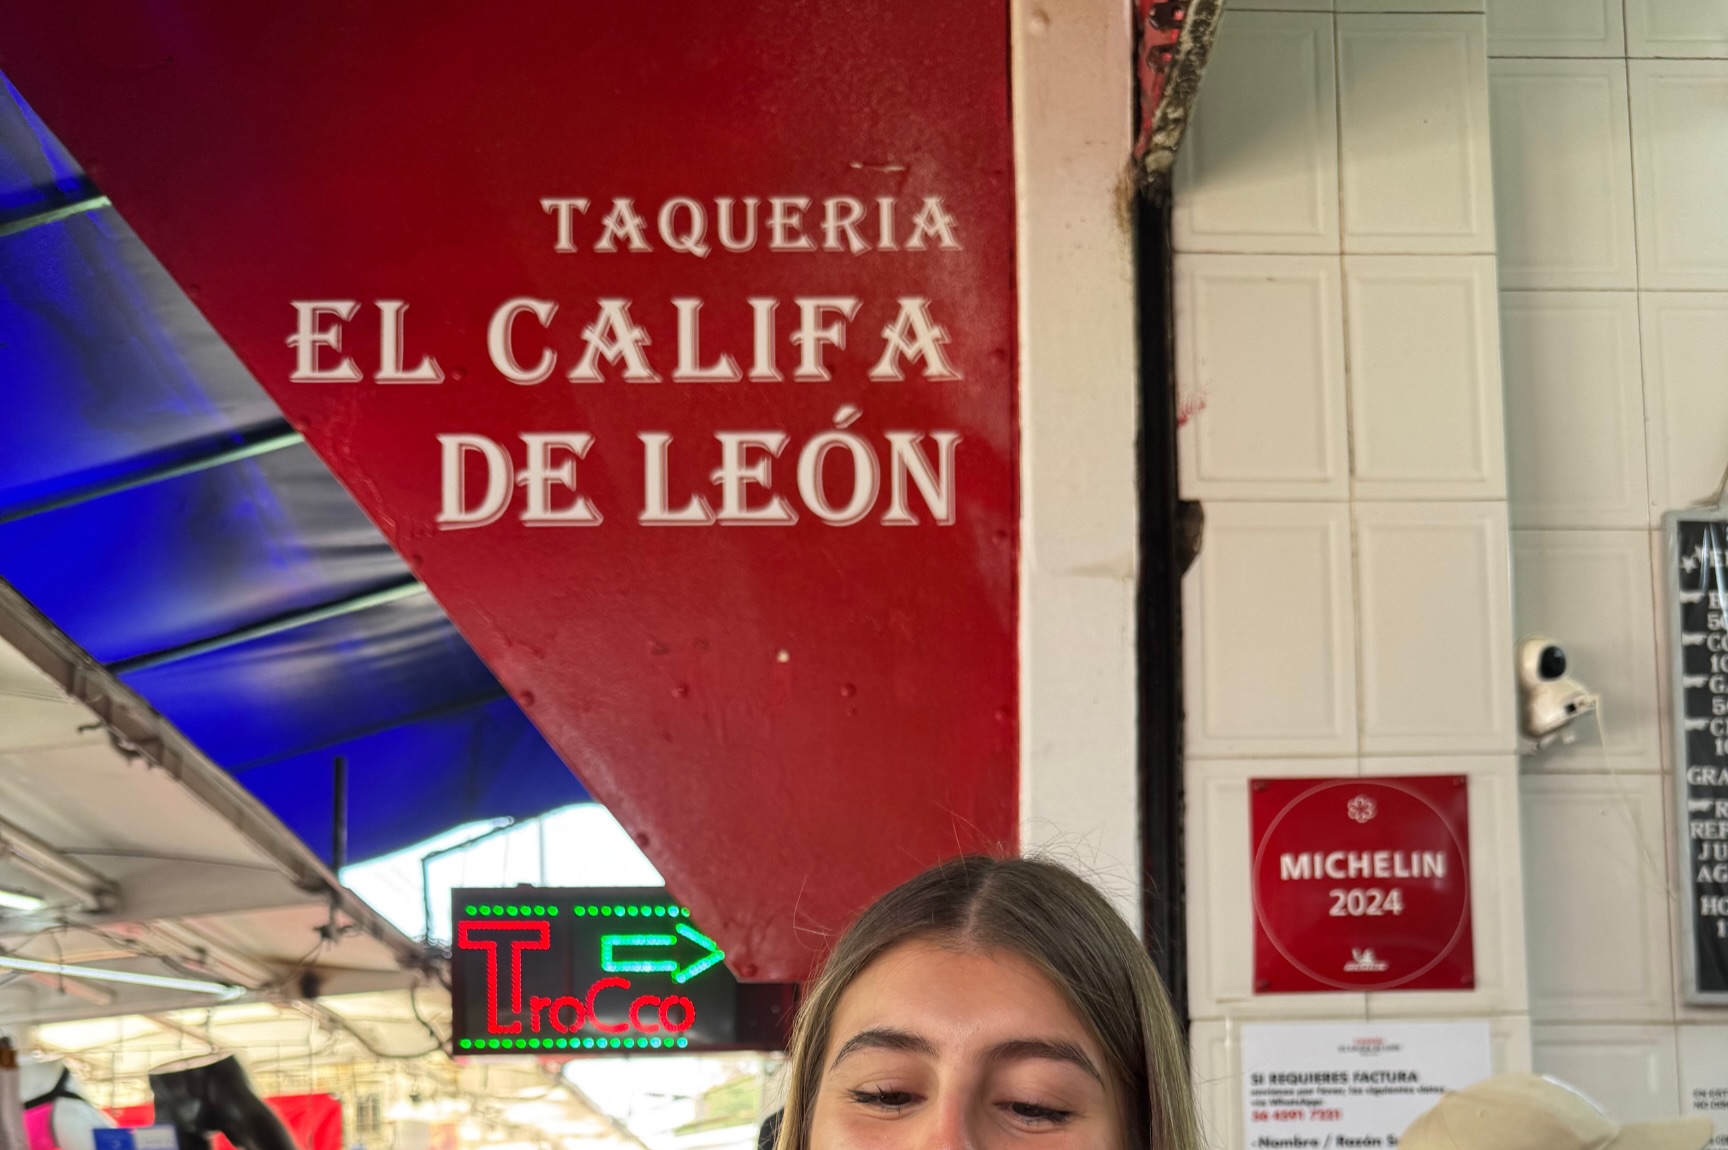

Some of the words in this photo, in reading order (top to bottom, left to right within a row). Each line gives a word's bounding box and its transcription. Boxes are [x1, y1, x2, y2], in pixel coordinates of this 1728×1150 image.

[541, 196, 962, 257] TAQUERIA
[286, 300, 444, 384] EL
[487, 296, 962, 385] CALIFA
[436, 432, 603, 530] DE
[638, 405, 962, 527] LEÓN
[1279, 850, 1447, 880] MICHELIN
[1328, 887, 1403, 916] 2024
[1269, 1071, 1348, 1085] REQUIERES
[1353, 1070, 1418, 1084] FACTURA
